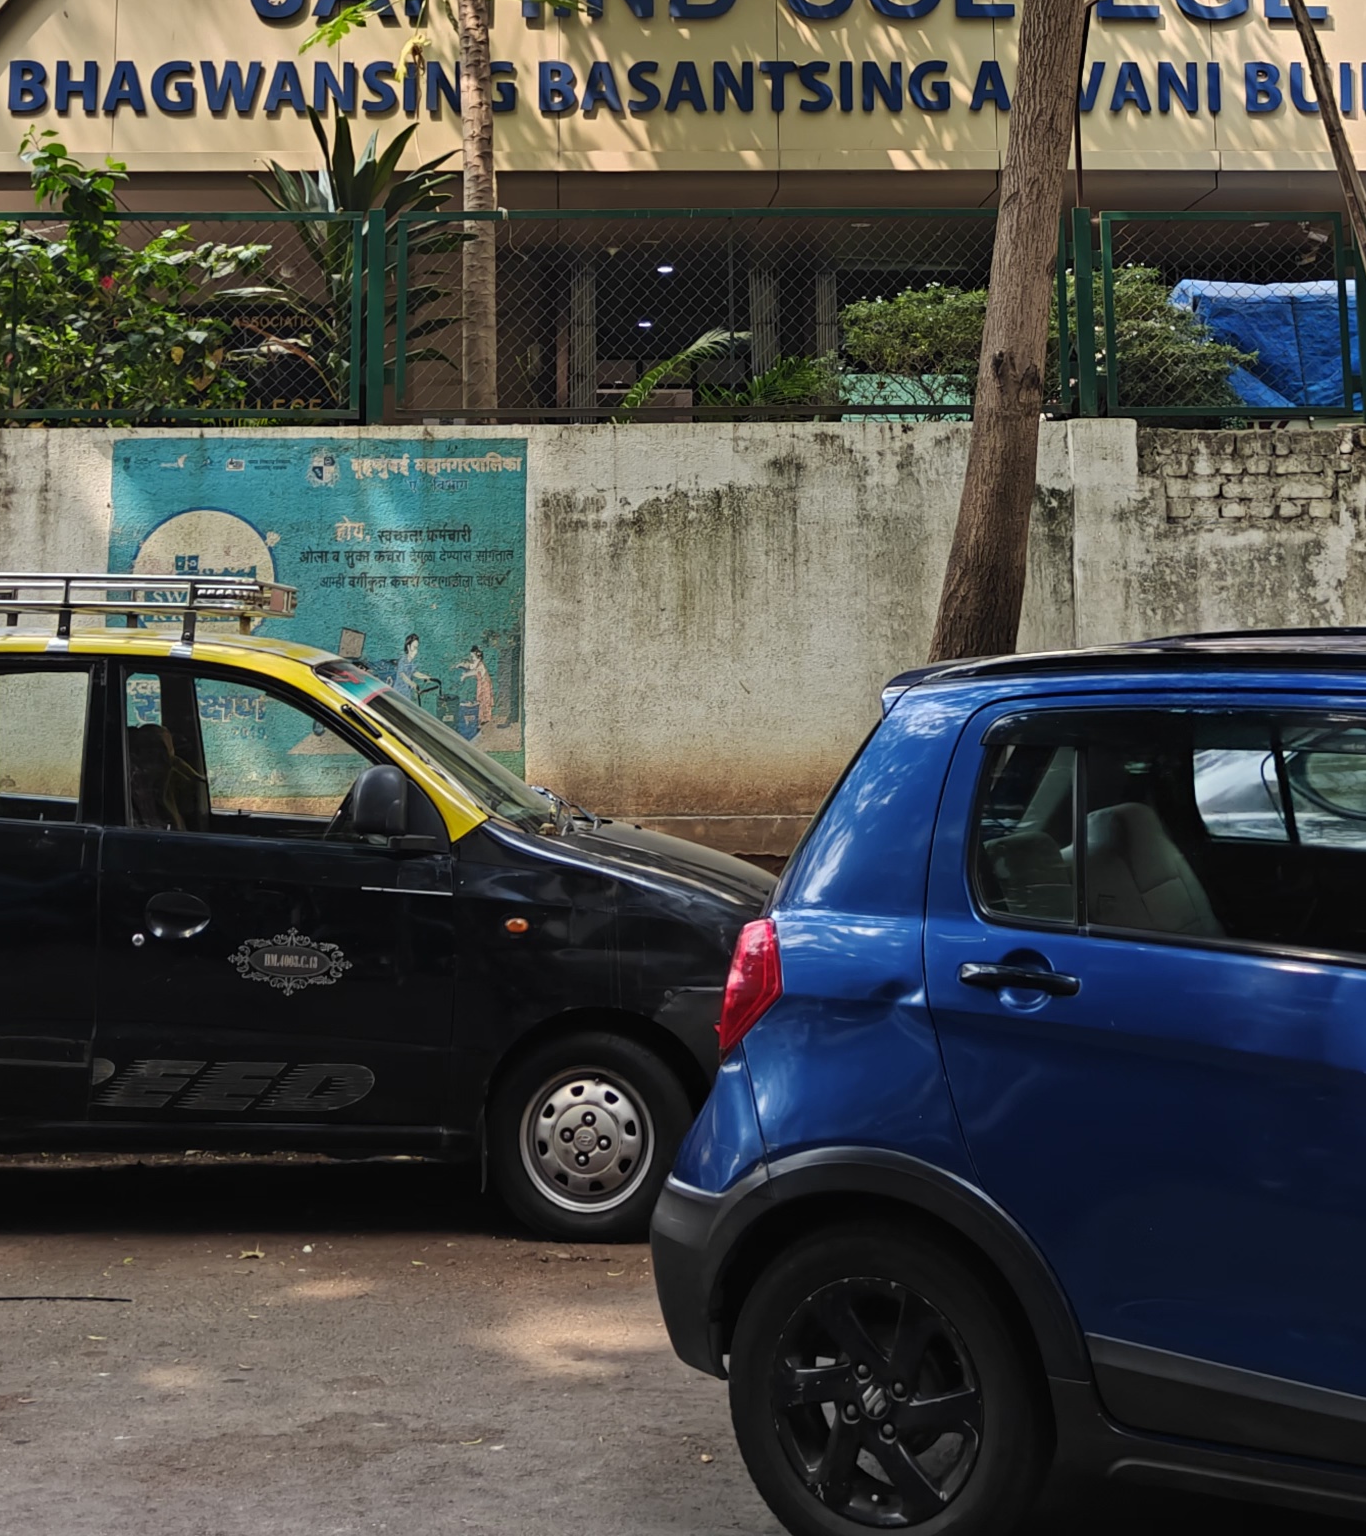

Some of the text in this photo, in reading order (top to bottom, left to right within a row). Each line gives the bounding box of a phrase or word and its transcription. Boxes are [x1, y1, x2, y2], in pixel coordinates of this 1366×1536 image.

[8, 60, 519, 114] BHAGWANSING
[538, 60, 952, 113] BASANTSING
[969, 60, 1223, 113] AVANI
